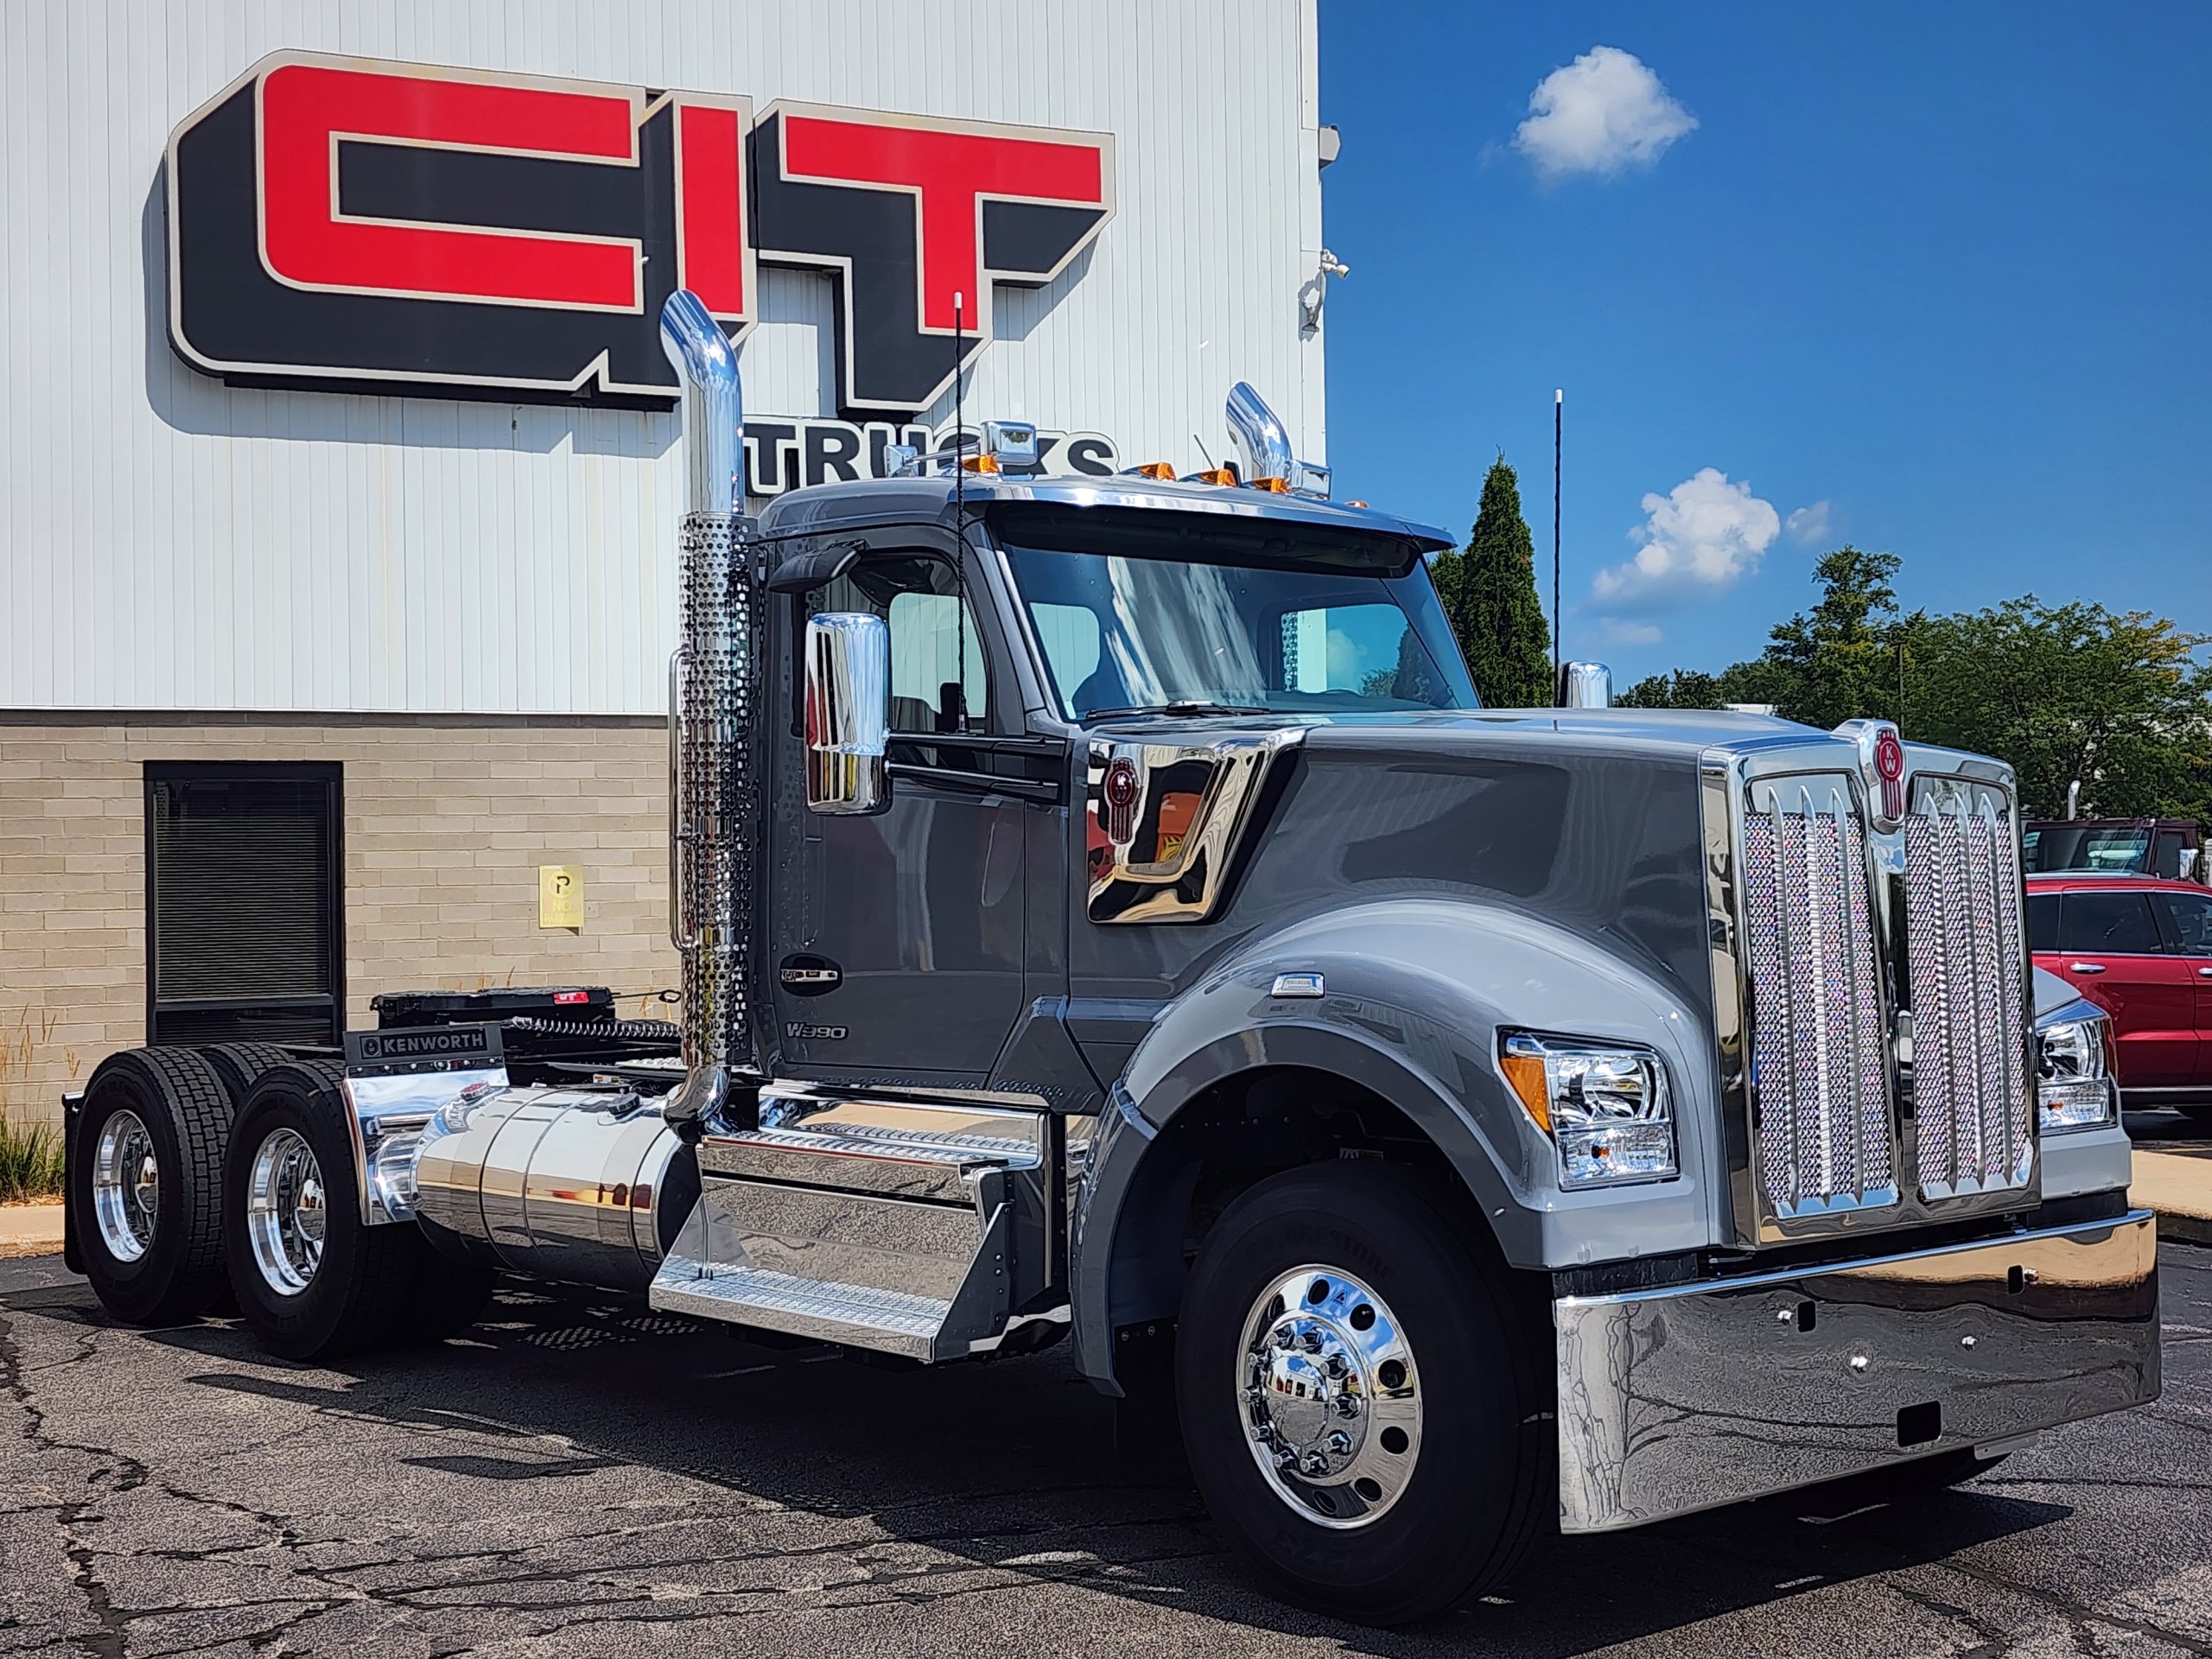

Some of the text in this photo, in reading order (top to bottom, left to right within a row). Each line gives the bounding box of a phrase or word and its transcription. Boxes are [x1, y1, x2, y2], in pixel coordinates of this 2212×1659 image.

[251, 54, 1115, 344] CIT
[1885, 745, 1894, 759] K
[1885, 759, 1897, 772] W
[552, 899, 572, 912] NO
[786, 1022, 847, 1039] W990
[384, 1033, 484, 1053] KENWORTH
